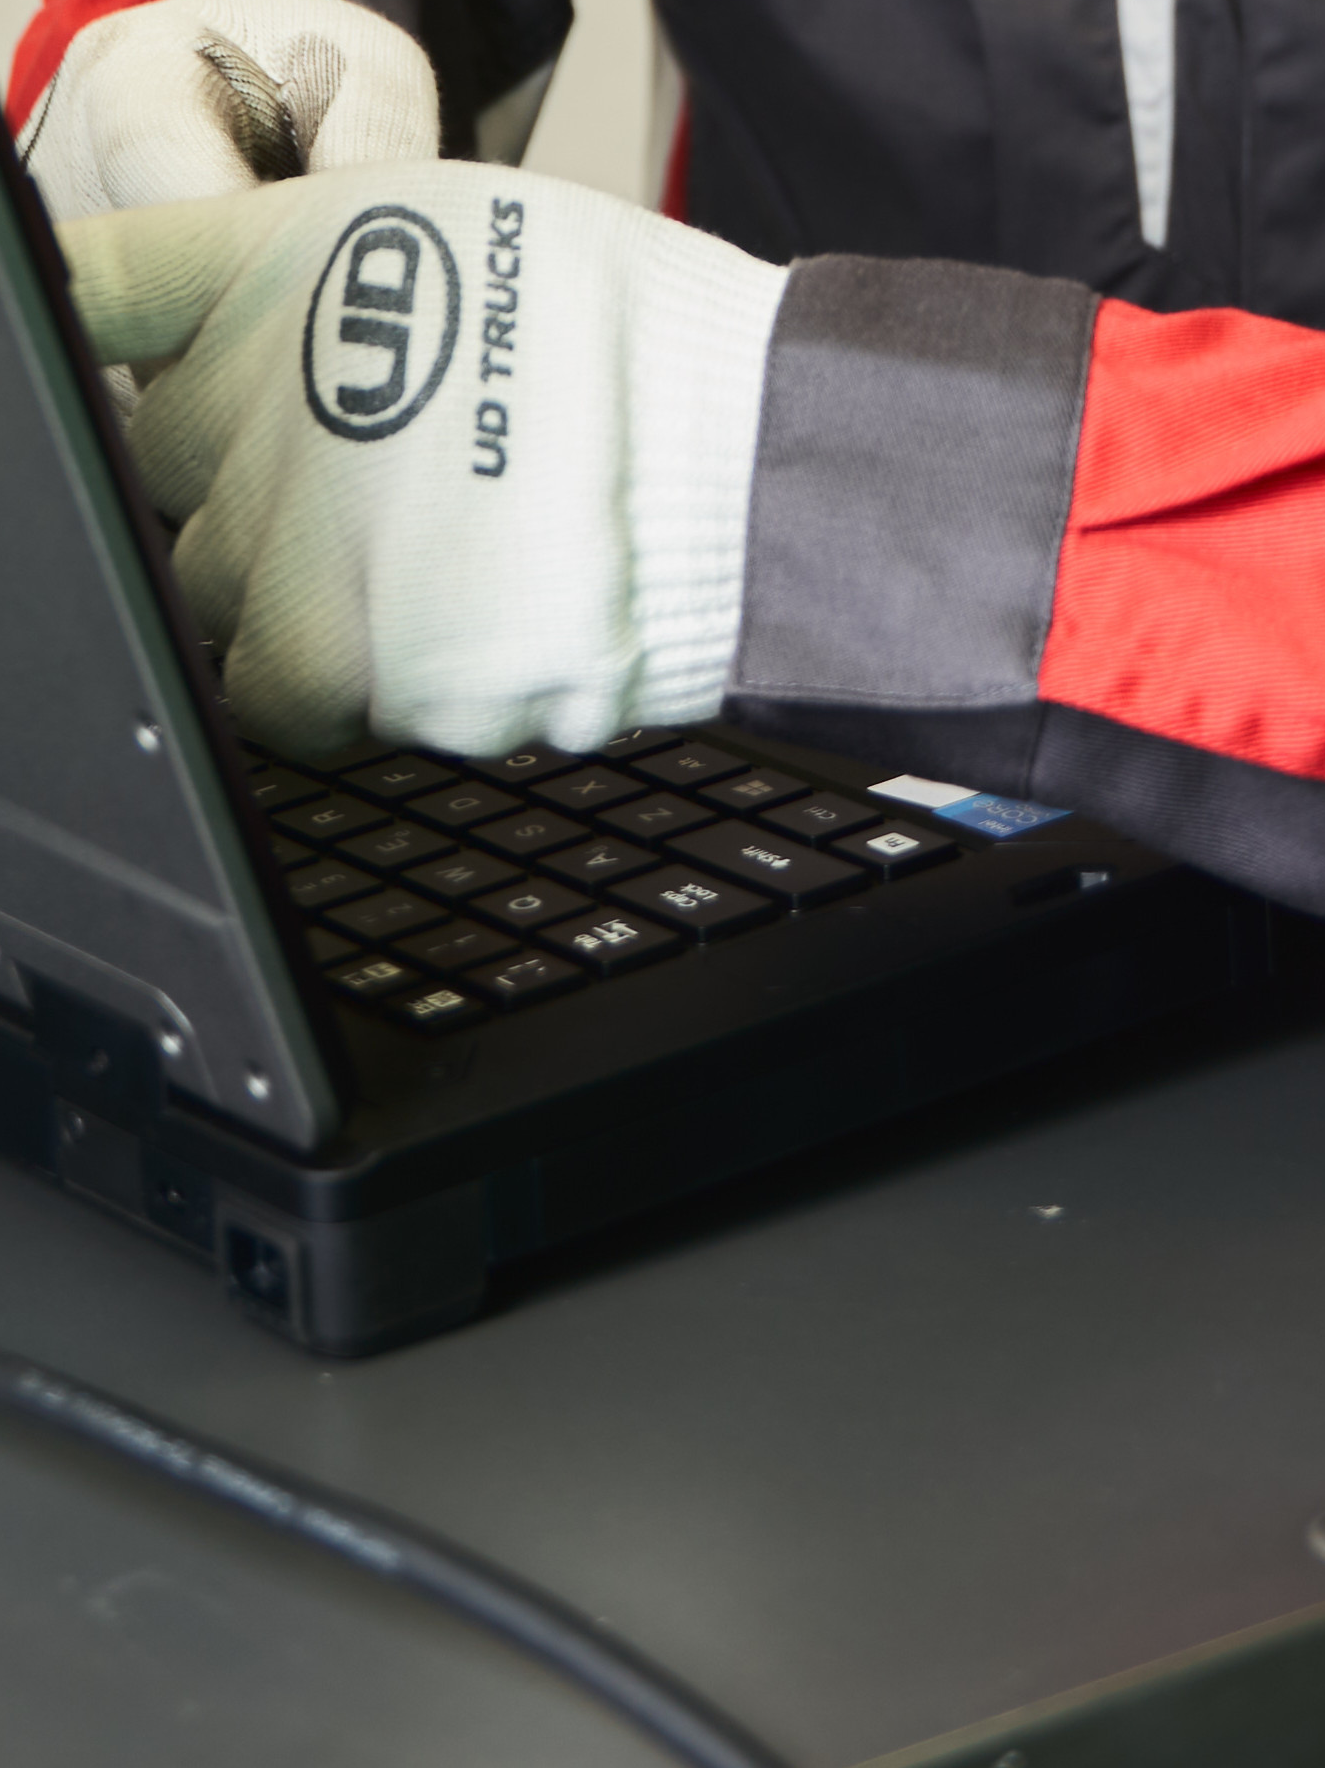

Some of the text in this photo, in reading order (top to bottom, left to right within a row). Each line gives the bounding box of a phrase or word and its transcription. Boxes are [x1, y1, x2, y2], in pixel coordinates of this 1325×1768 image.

[336, 226, 421, 416] UD
[472, 197, 525, 478] UD TRUCKS
[678, 756, 707, 769] Alt
[382, 771, 416, 784] F
[571, 780, 607, 794] X
[448, 797, 481, 810] D
[311, 810, 345, 824] R
[639, 807, 674, 822] Z
[803, 805, 838, 820] Ctrl
[515, 824, 546, 838] S
[376, 838, 409, 854] E
[586, 851, 618, 867] A
[741, 845, 781, 864] Shift
[435, 866, 475, 883] W
[660, 890, 697, 907] Caps
[679, 883, 719, 900] Lock
[508, 894, 542, 912] Q
[573, 933, 603, 949] Tab
